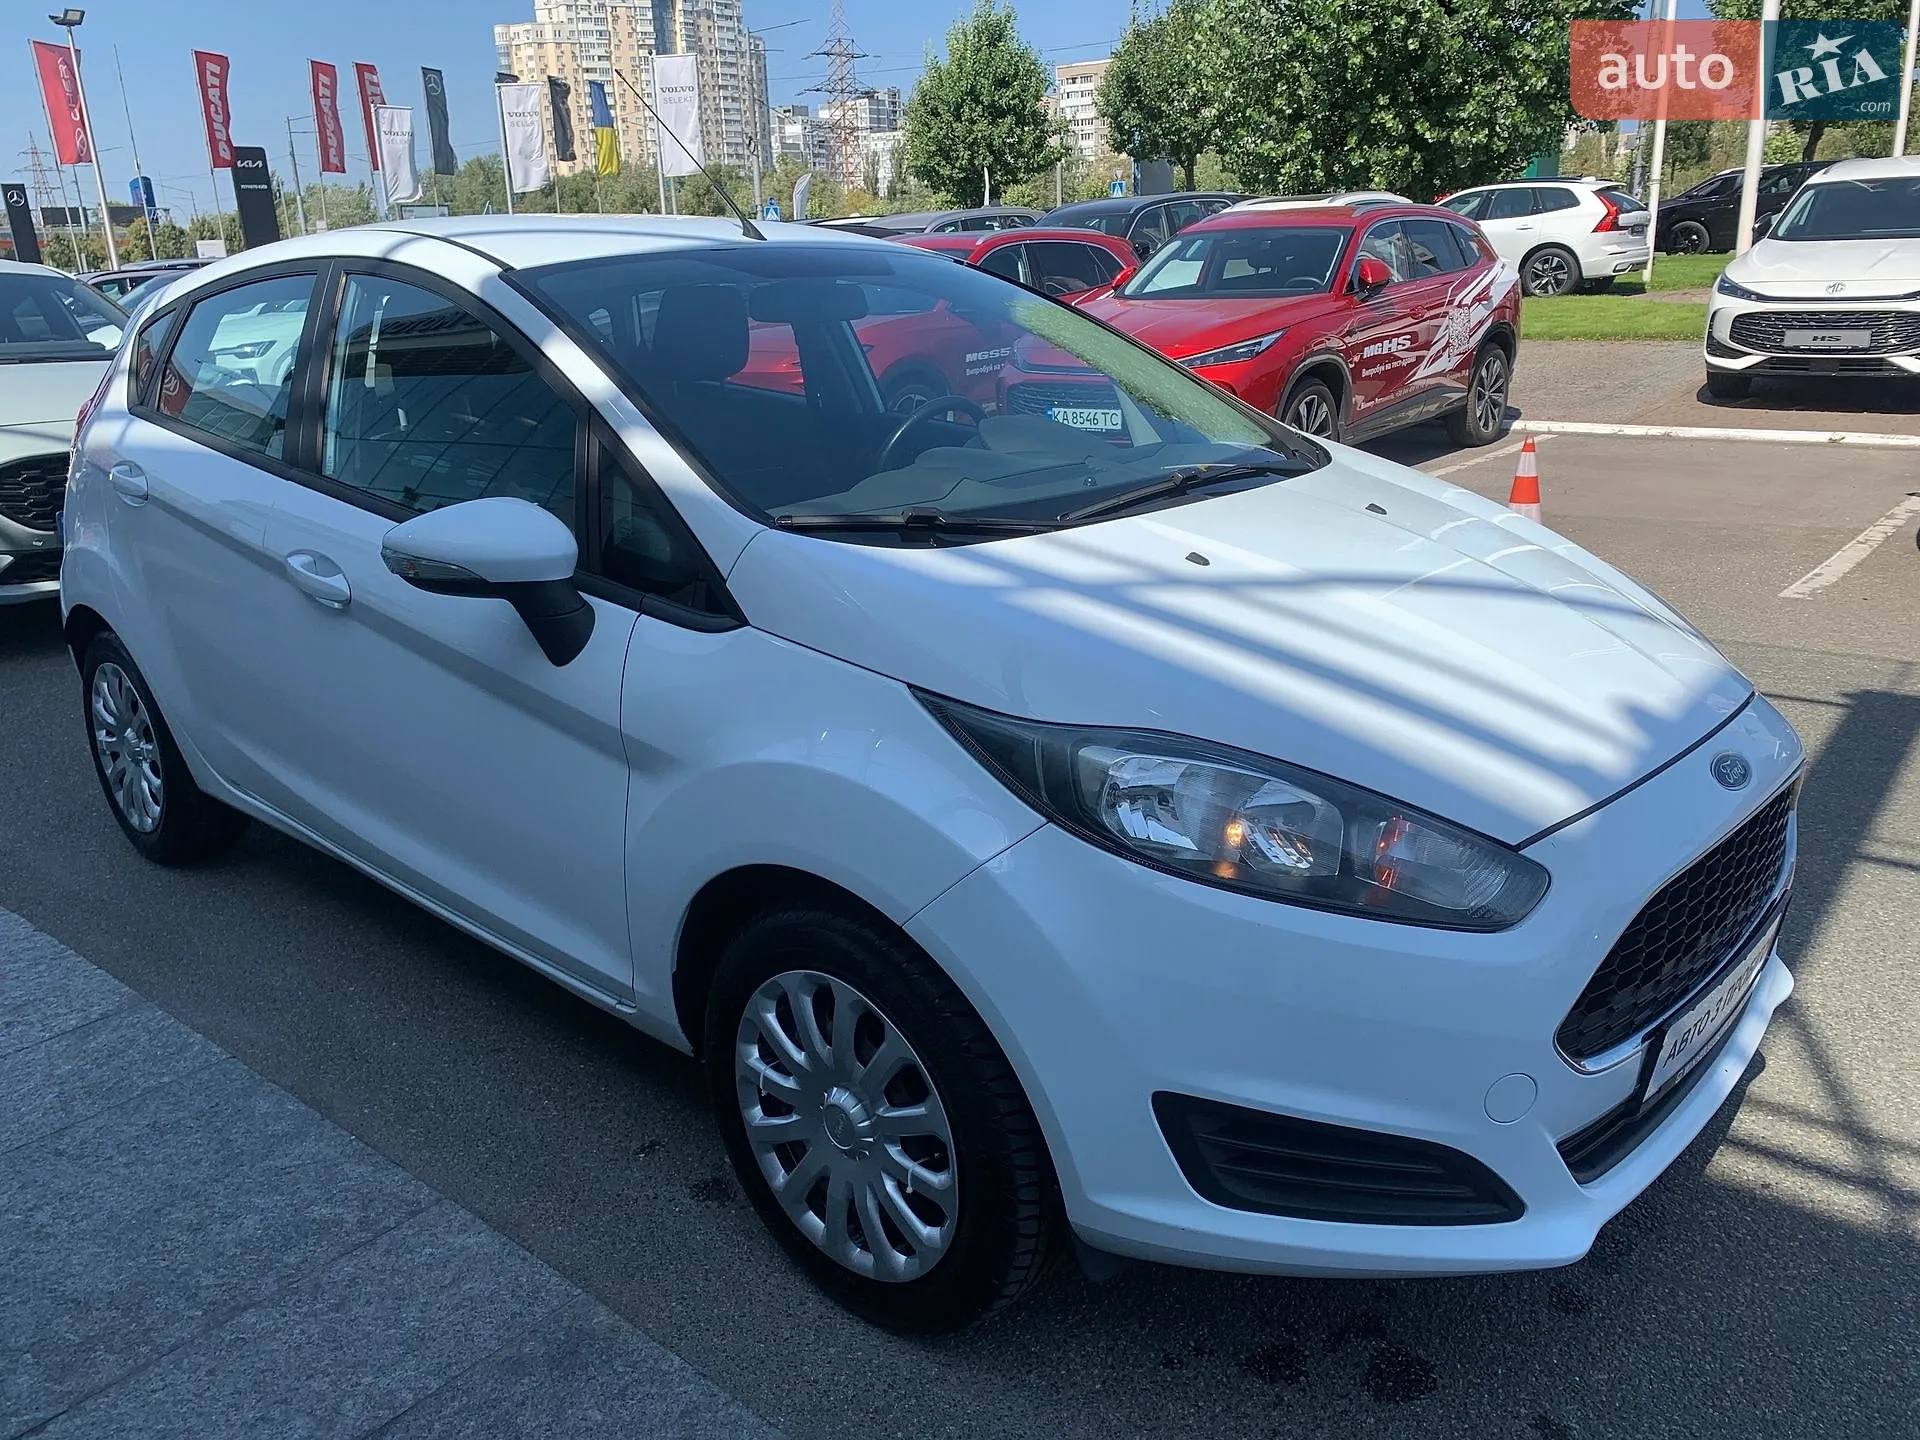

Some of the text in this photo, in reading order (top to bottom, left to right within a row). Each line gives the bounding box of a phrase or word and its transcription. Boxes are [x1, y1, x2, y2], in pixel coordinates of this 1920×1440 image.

[659, 85, 695, 93] VOLVO
[663, 96, 693, 104] SELEKT
[205, 61, 231, 161] DUCATI
[318, 73, 342, 168] DUCATI
[965, 346, 1012, 363] MGS5
[1053, 410, 1119, 427] KA 8546 TC
[1662, 1009, 1711, 1069] АВТО
